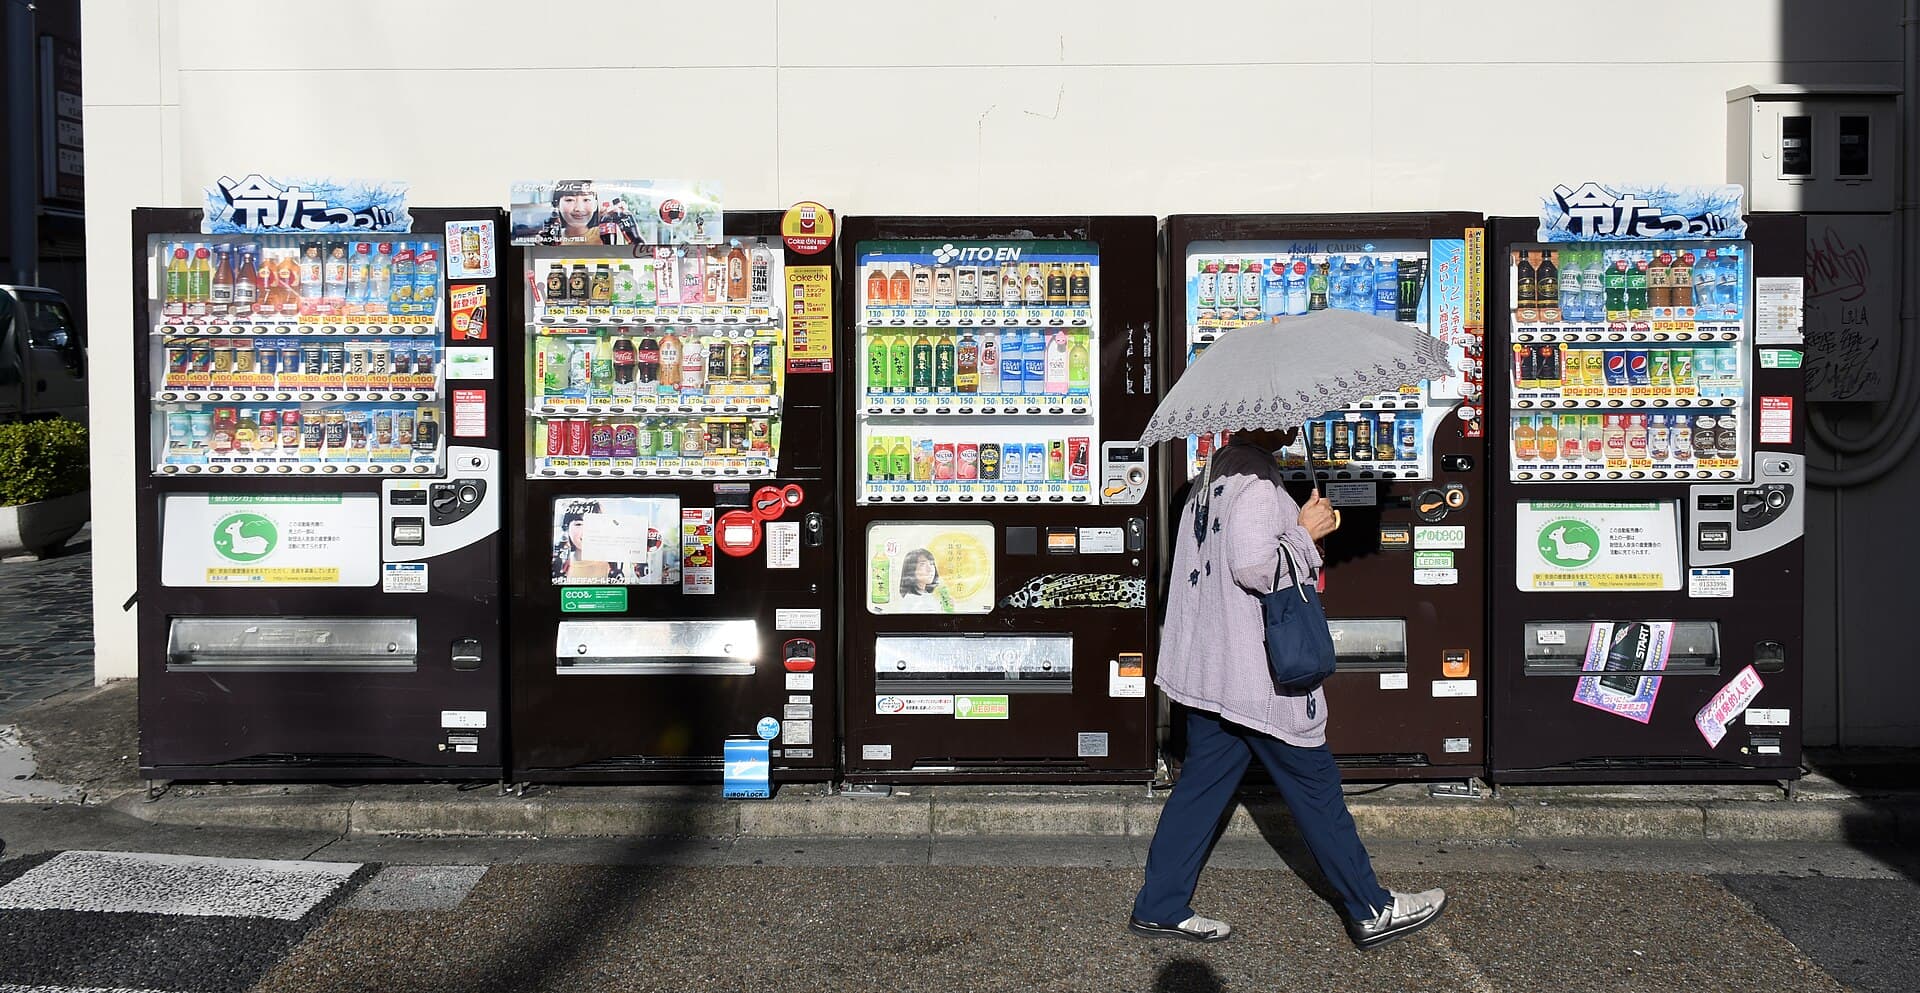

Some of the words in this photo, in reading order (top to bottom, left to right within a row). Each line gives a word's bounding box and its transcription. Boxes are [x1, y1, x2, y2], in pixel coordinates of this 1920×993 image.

[959, 247, 993, 261] ITO
[995, 247, 1021, 261] EN
[1326, 243, 1361, 253] CALPIS
[752, 284, 767, 292] SAN
[354, 353, 363, 373] BOS
[376, 353, 385, 373] BOS
[1418, 558, 1449, 566] LED照明
[1636, 626, 1649, 660] START
